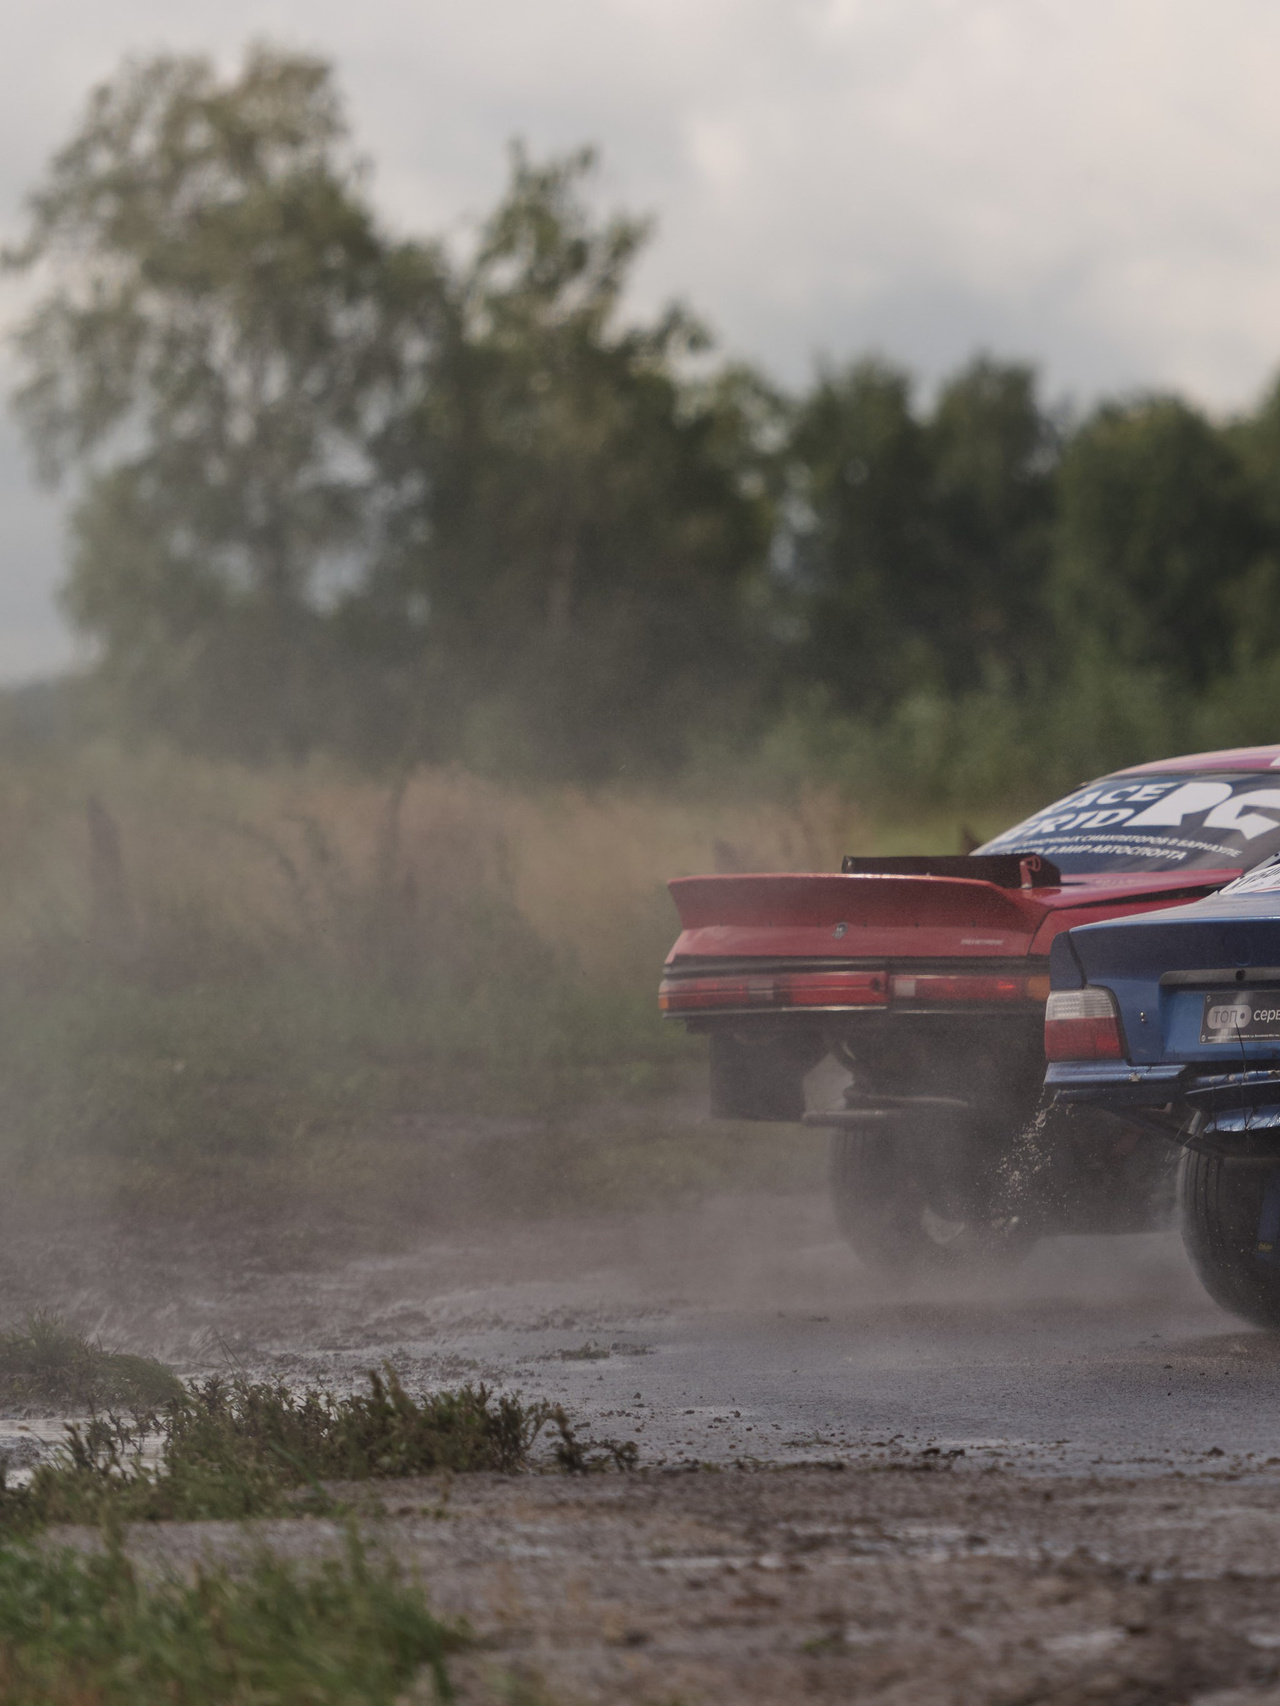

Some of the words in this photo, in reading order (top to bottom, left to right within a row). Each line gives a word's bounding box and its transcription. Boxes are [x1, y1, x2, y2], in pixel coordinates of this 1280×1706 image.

[1087, 844, 1187, 860] АВТОСПОРТА
[1177, 839, 1243, 858] БАРНАУЛЕ
[1213, 1010, 1238, 1024] ТОП
